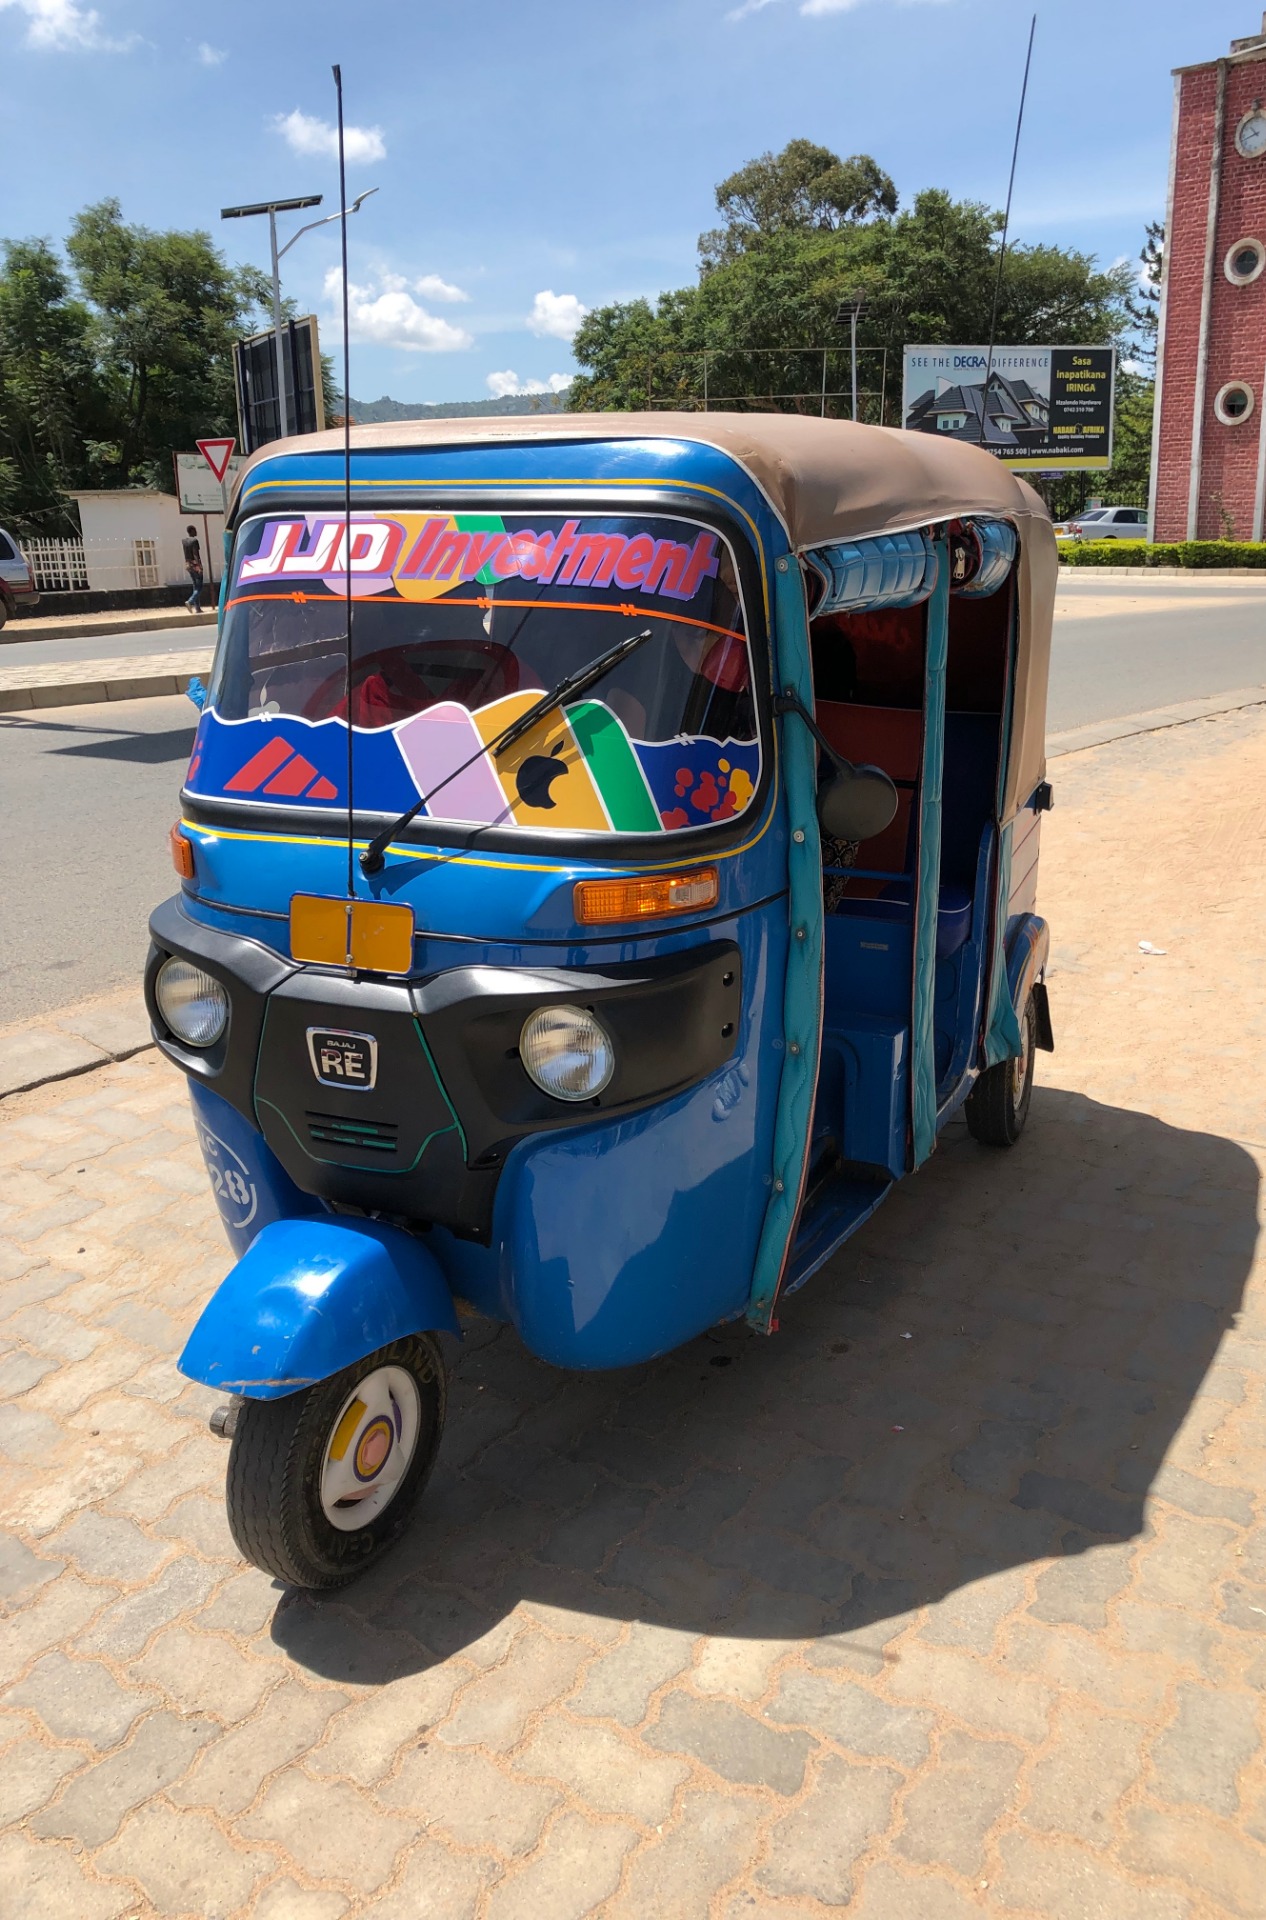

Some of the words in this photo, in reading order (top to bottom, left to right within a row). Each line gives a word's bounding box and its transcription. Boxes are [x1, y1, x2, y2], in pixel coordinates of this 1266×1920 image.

[911, 357, 928, 367] SEE
[932, 357, 950, 367] THE
[953, 356, 987, 368] DECRA
[991, 357, 1049, 368] DIFFERENCE
[1072, 355, 1092, 366] Sasa
[1066, 383, 1096, 393] IRINGA
[1053, 426, 1076, 434] NABAKI
[1083, 426, 1105, 434] AFRIKA
[1003, 447, 1014, 455] 765
[1015, 447, 1027, 455] 508
[1031, 446, 1084, 455] www.nabaki.com
[237, 519, 407, 588] JJD
[397, 519, 719, 601] Investment
[327, 1040, 356, 1050] BAJAJ
[321, 1048, 365, 1078] RE
[207, 1163, 250, 1205] 28
